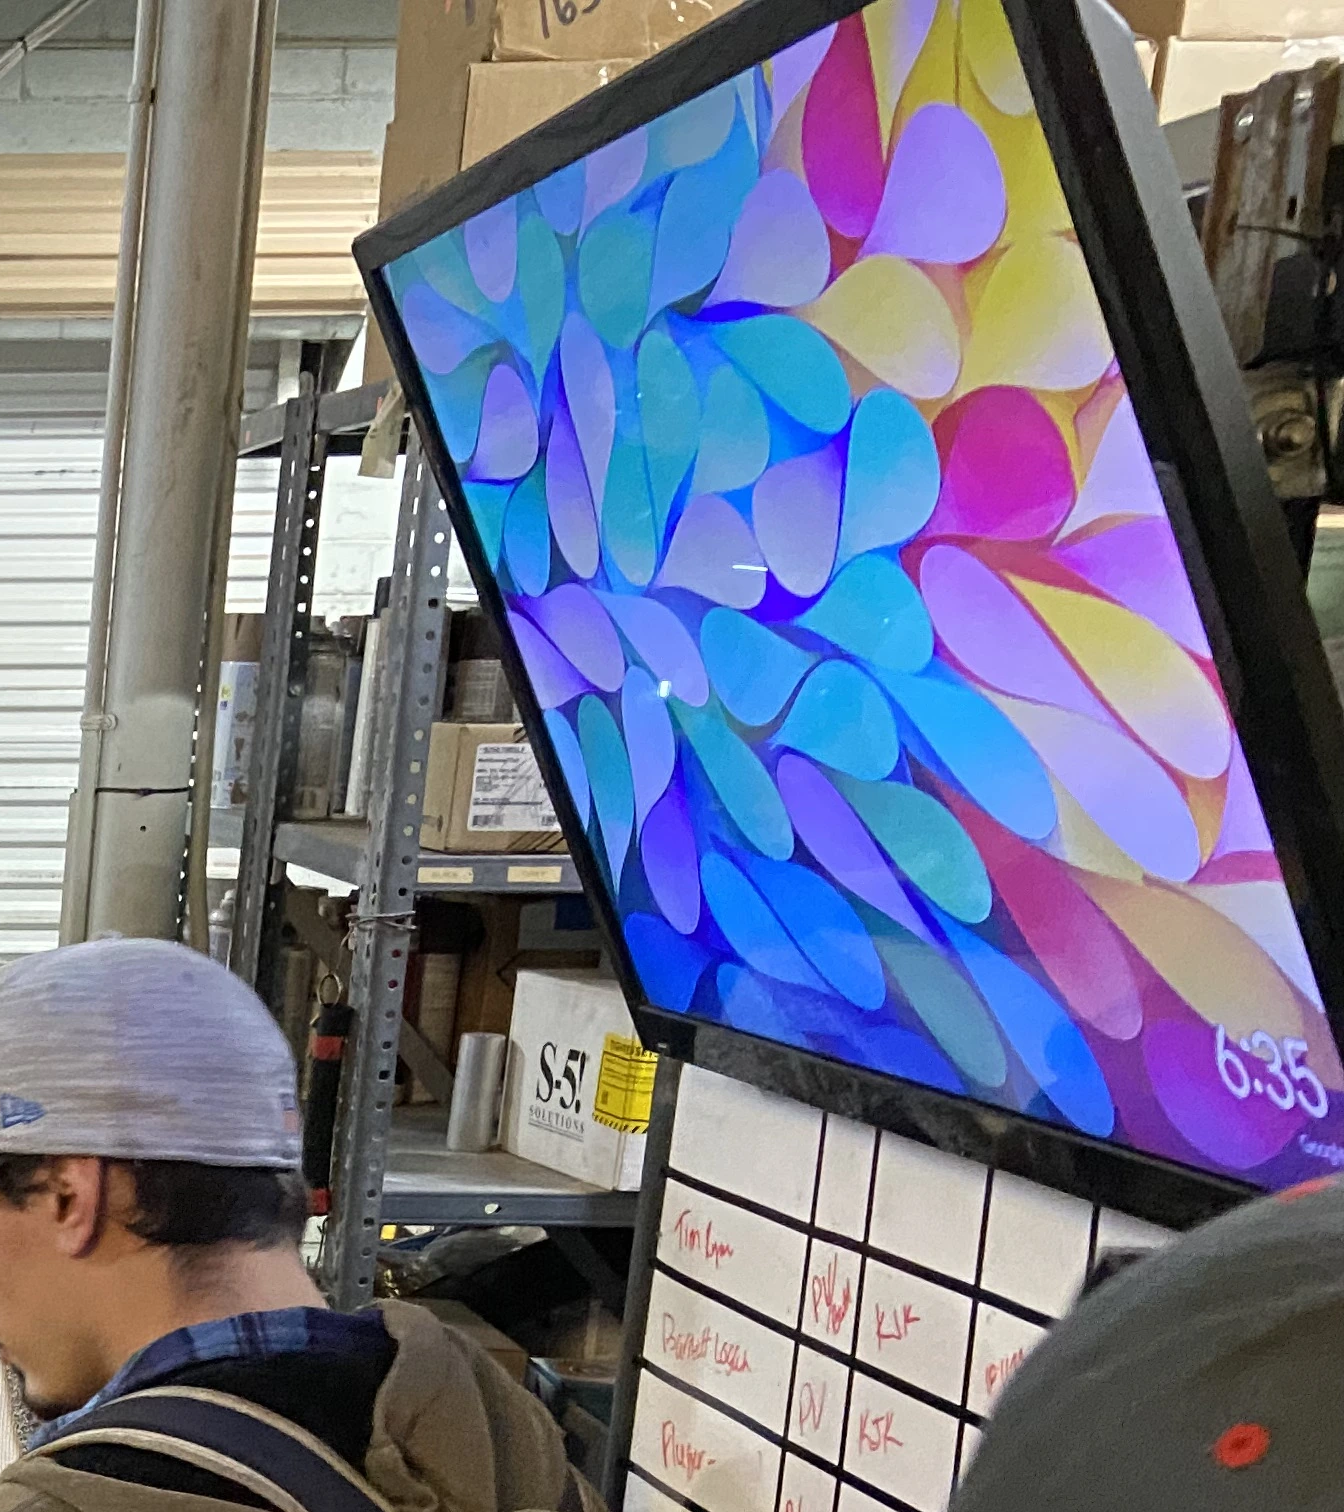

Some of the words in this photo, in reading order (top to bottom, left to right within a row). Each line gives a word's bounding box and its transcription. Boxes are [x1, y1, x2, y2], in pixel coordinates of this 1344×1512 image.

[536, 1041, 587, 1115] S-5!
[1215, 1023, 1329, 1118] 6:35
[528, 1104, 585, 1132] SOLUTIONS
[858, 1408, 903, 1455] KJK
